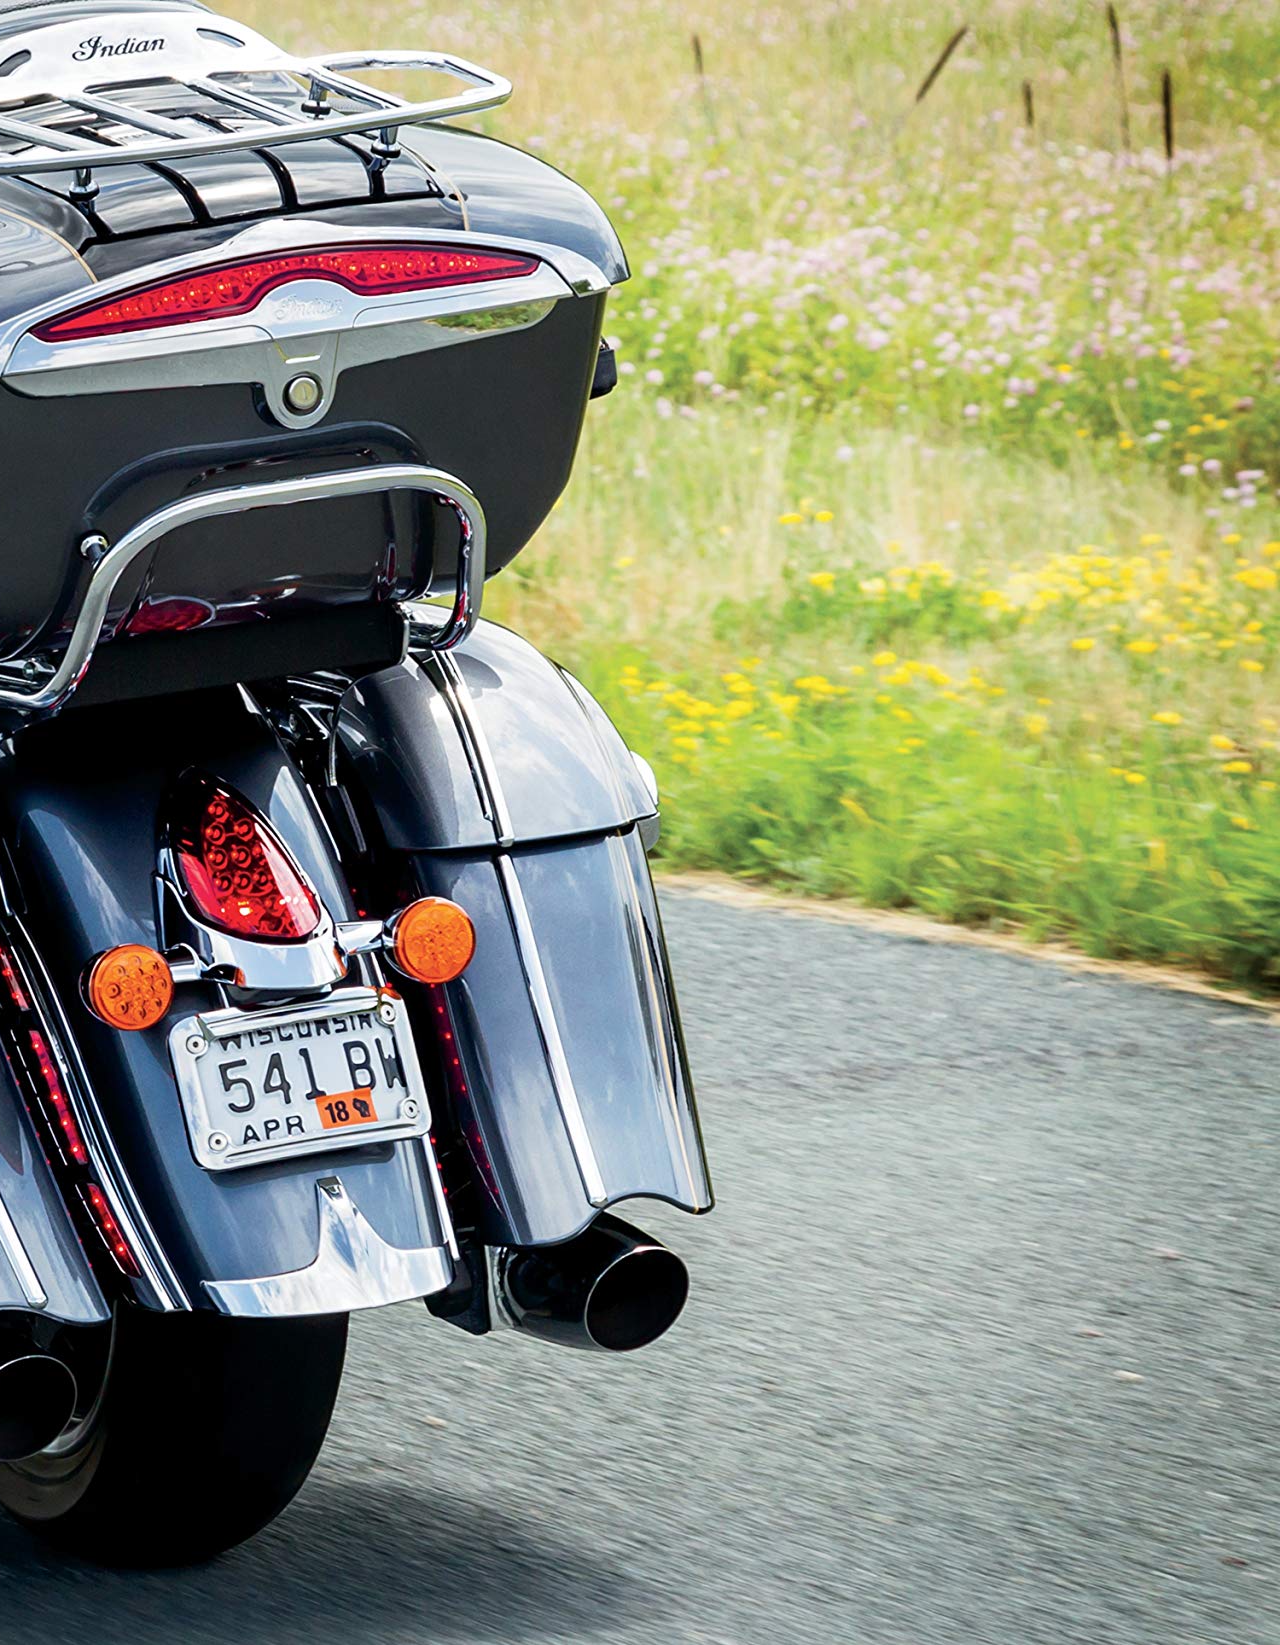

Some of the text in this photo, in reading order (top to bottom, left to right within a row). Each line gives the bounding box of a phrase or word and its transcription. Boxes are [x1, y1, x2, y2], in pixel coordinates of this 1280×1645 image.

[72, 35, 165, 61] Indian
[220, 1013, 373, 1051] WISCONSIN
[218, 1036, 408, 1113] 541 BW
[324, 1100, 350, 1123] 18
[243, 1115, 305, 1144] APR
